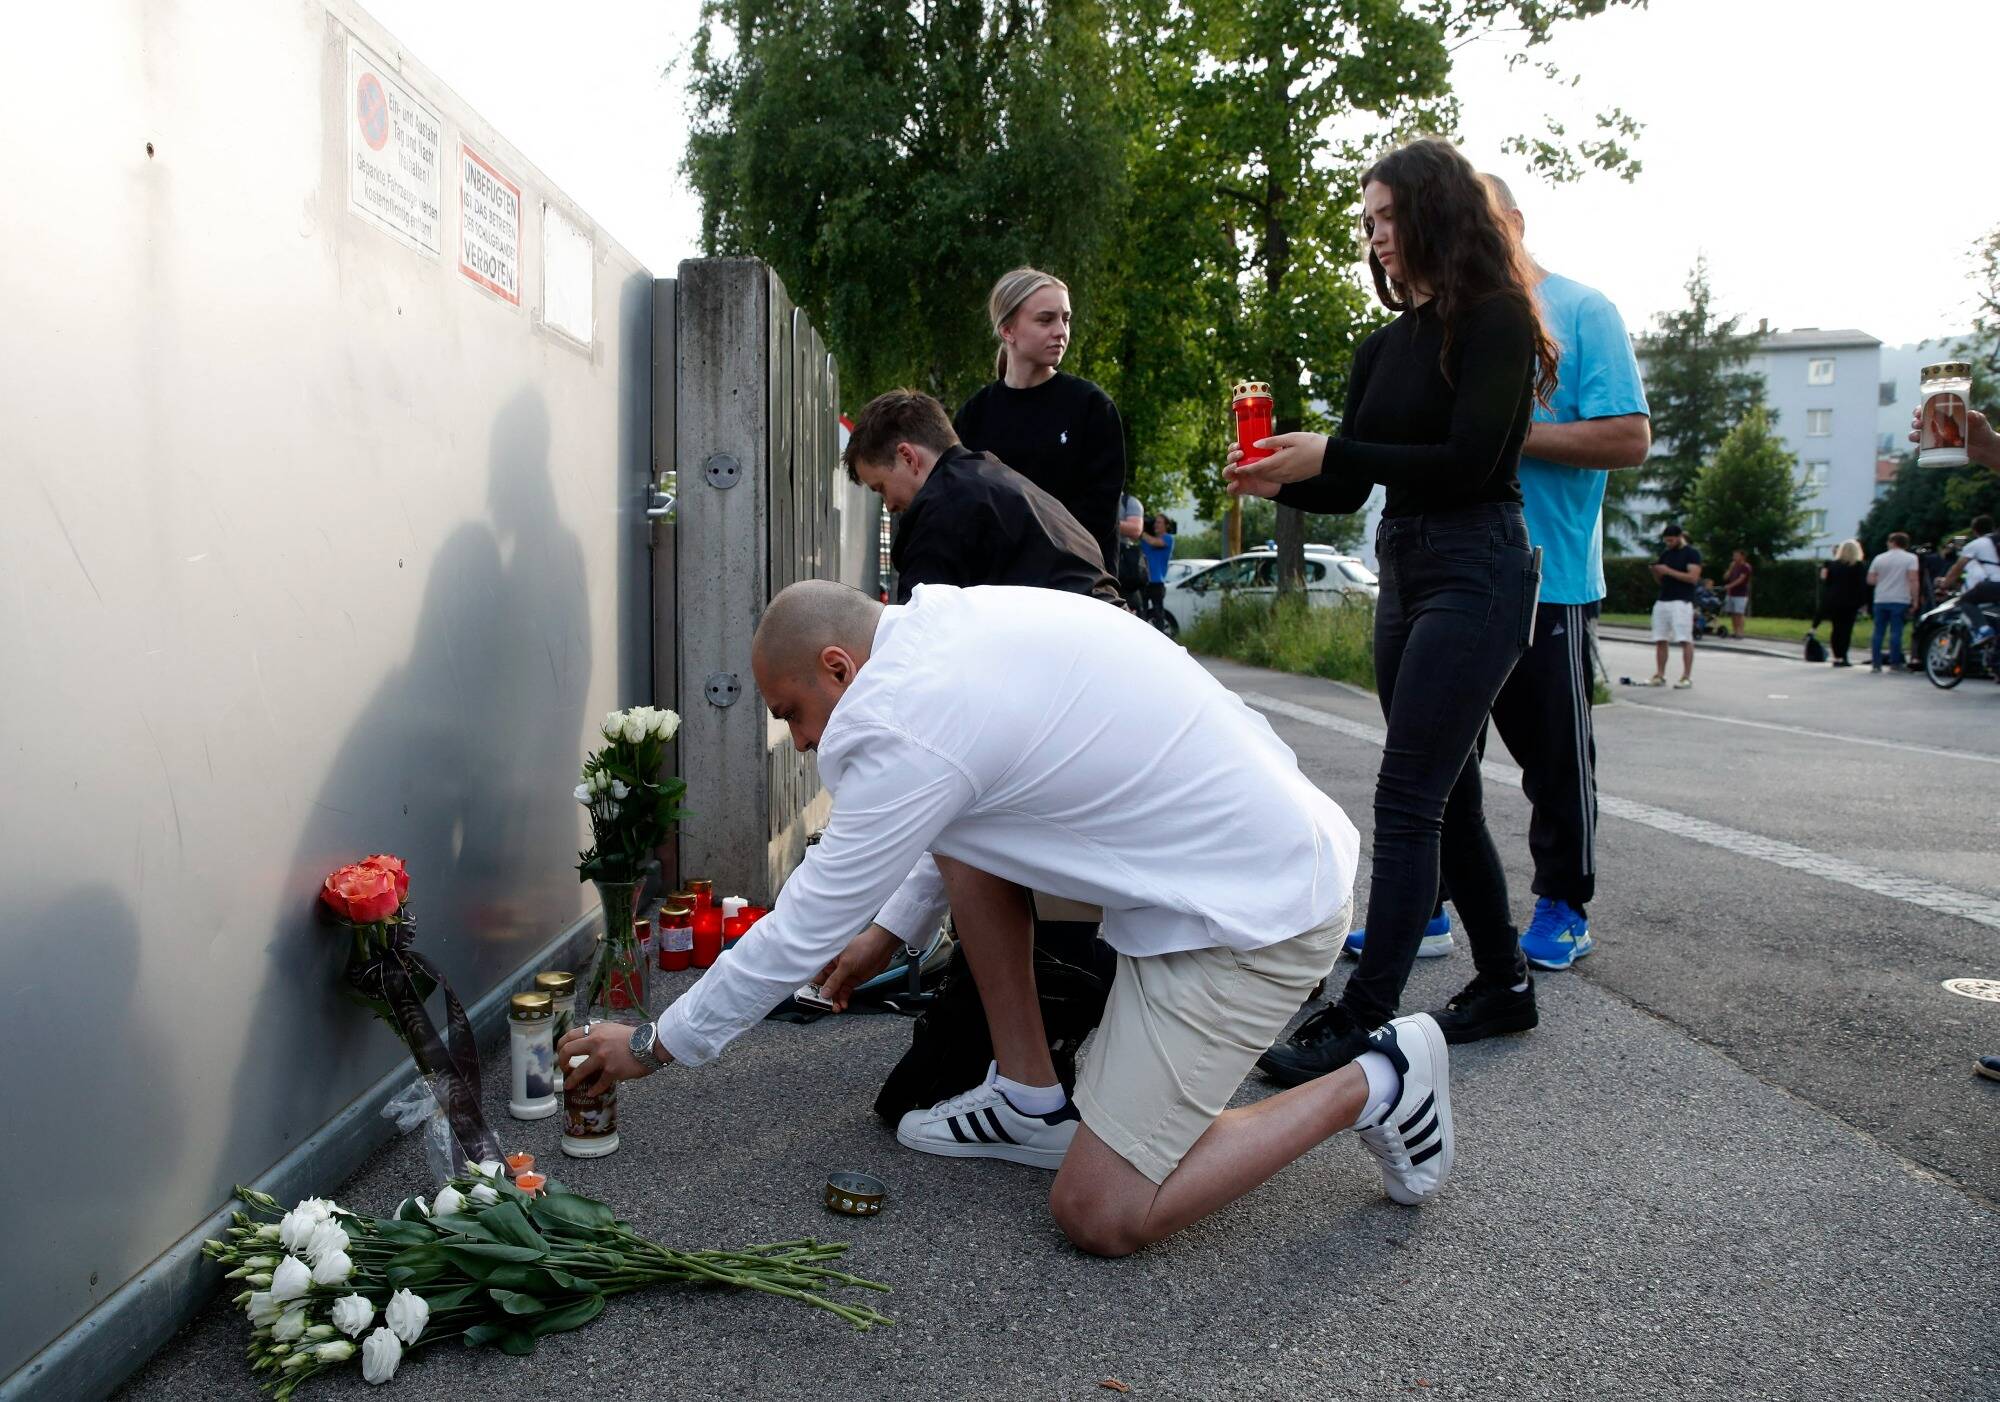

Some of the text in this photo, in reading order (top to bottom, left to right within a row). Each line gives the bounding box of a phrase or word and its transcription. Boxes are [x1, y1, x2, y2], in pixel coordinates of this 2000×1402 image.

[388, 92, 439, 147] Ein- und Ausfahrt
[393, 119, 435, 167] Tag und Nacht
[356, 152, 386, 186] Geparkte
[386, 172, 418, 209] Fahrzeuge
[464, 159, 516, 219] UNBEFUGTEN
[463, 190, 516, 241] IST DAS BETRETEN
[463, 213, 474, 233] DES
